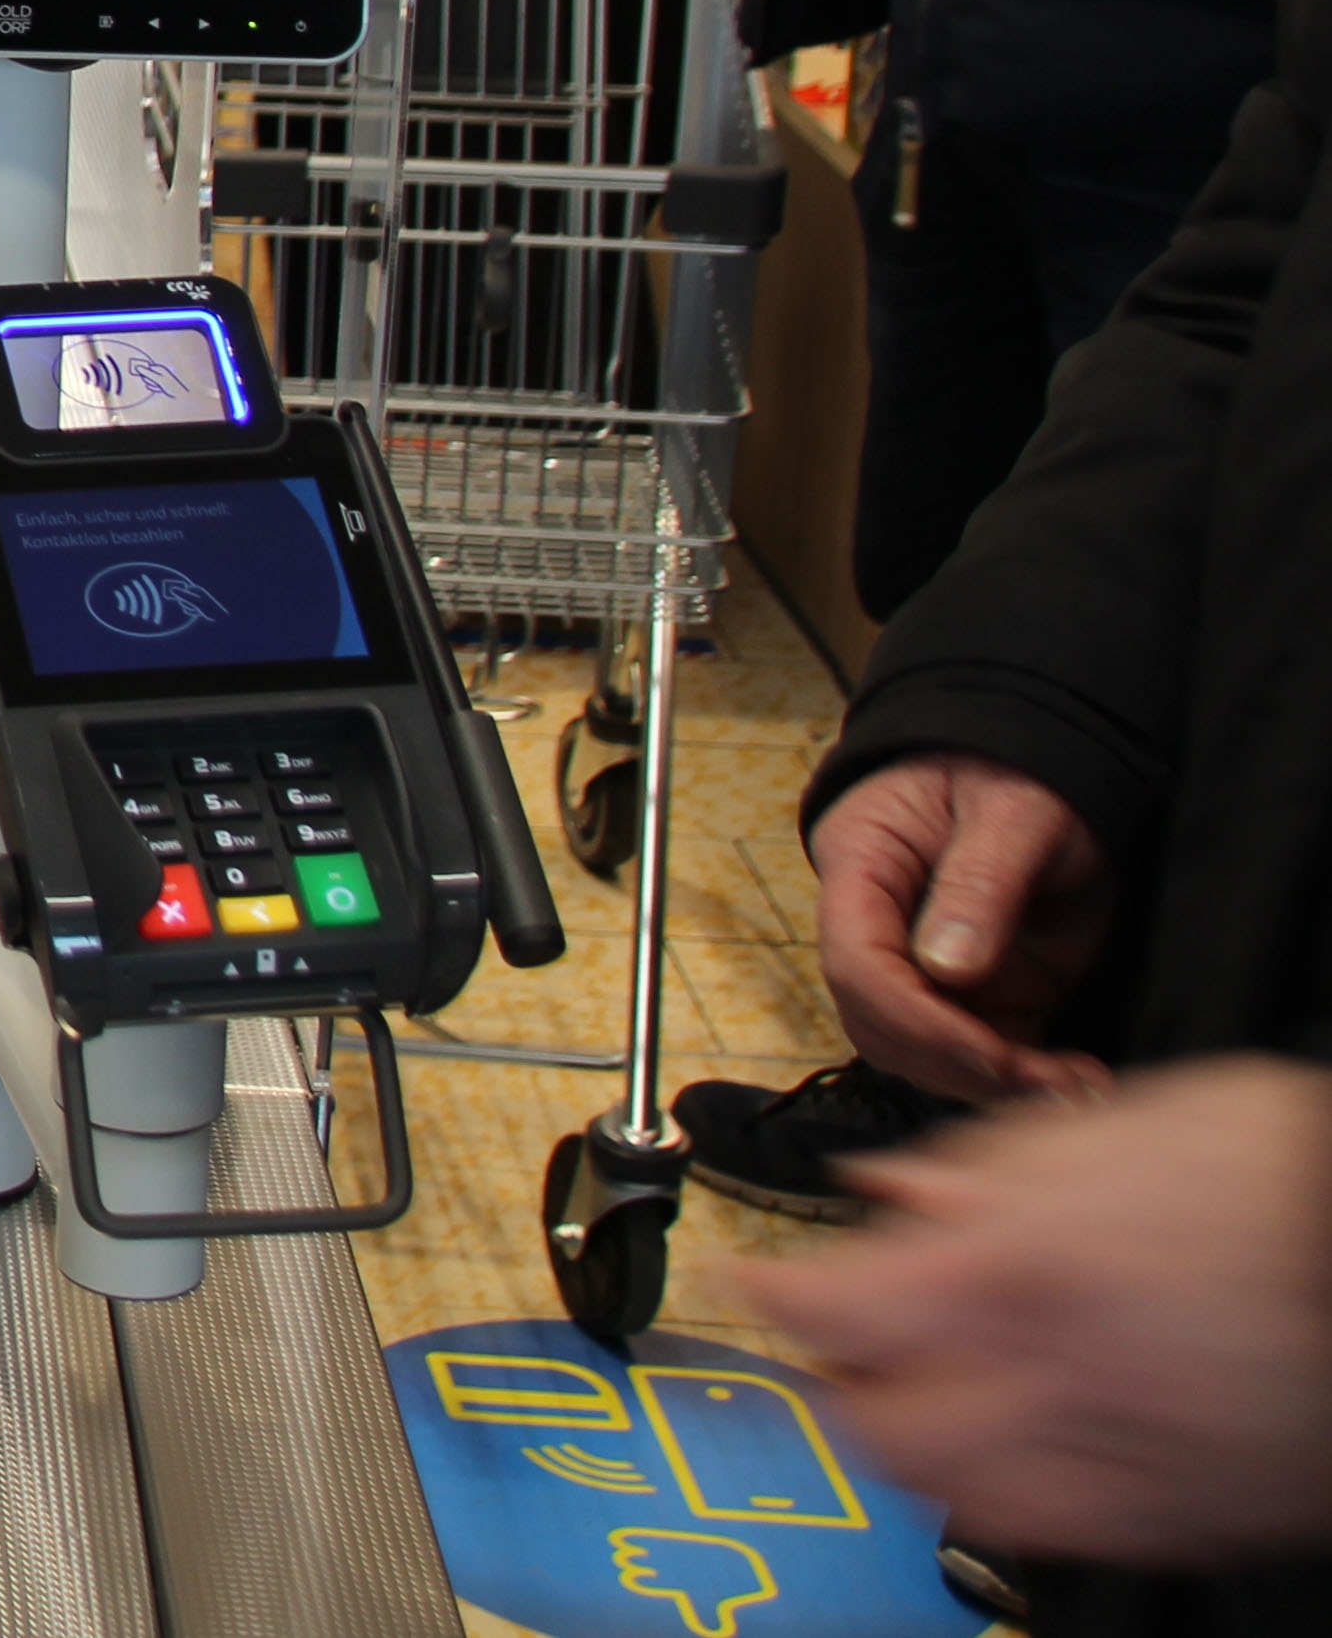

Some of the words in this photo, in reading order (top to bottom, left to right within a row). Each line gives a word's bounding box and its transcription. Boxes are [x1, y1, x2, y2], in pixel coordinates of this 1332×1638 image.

[16, 510, 82, 528] Einfach,
[85, 508, 132, 524] sicher
[136, 505, 168, 522] und
[170, 501, 230, 519] schnell:
[21, 530, 108, 550] Kontaktlos
[111, 527, 184, 546] bezahlen
[192, 756, 209, 774] 2
[274, 752, 291, 770] 3
[203, 793, 221, 811] 5
[287, 788, 304, 805] 6
[122, 797, 139, 816] 4
[214, 829, 233, 848] 8
[296, 824, 314, 842] 9
[225, 867, 246, 885] 0
